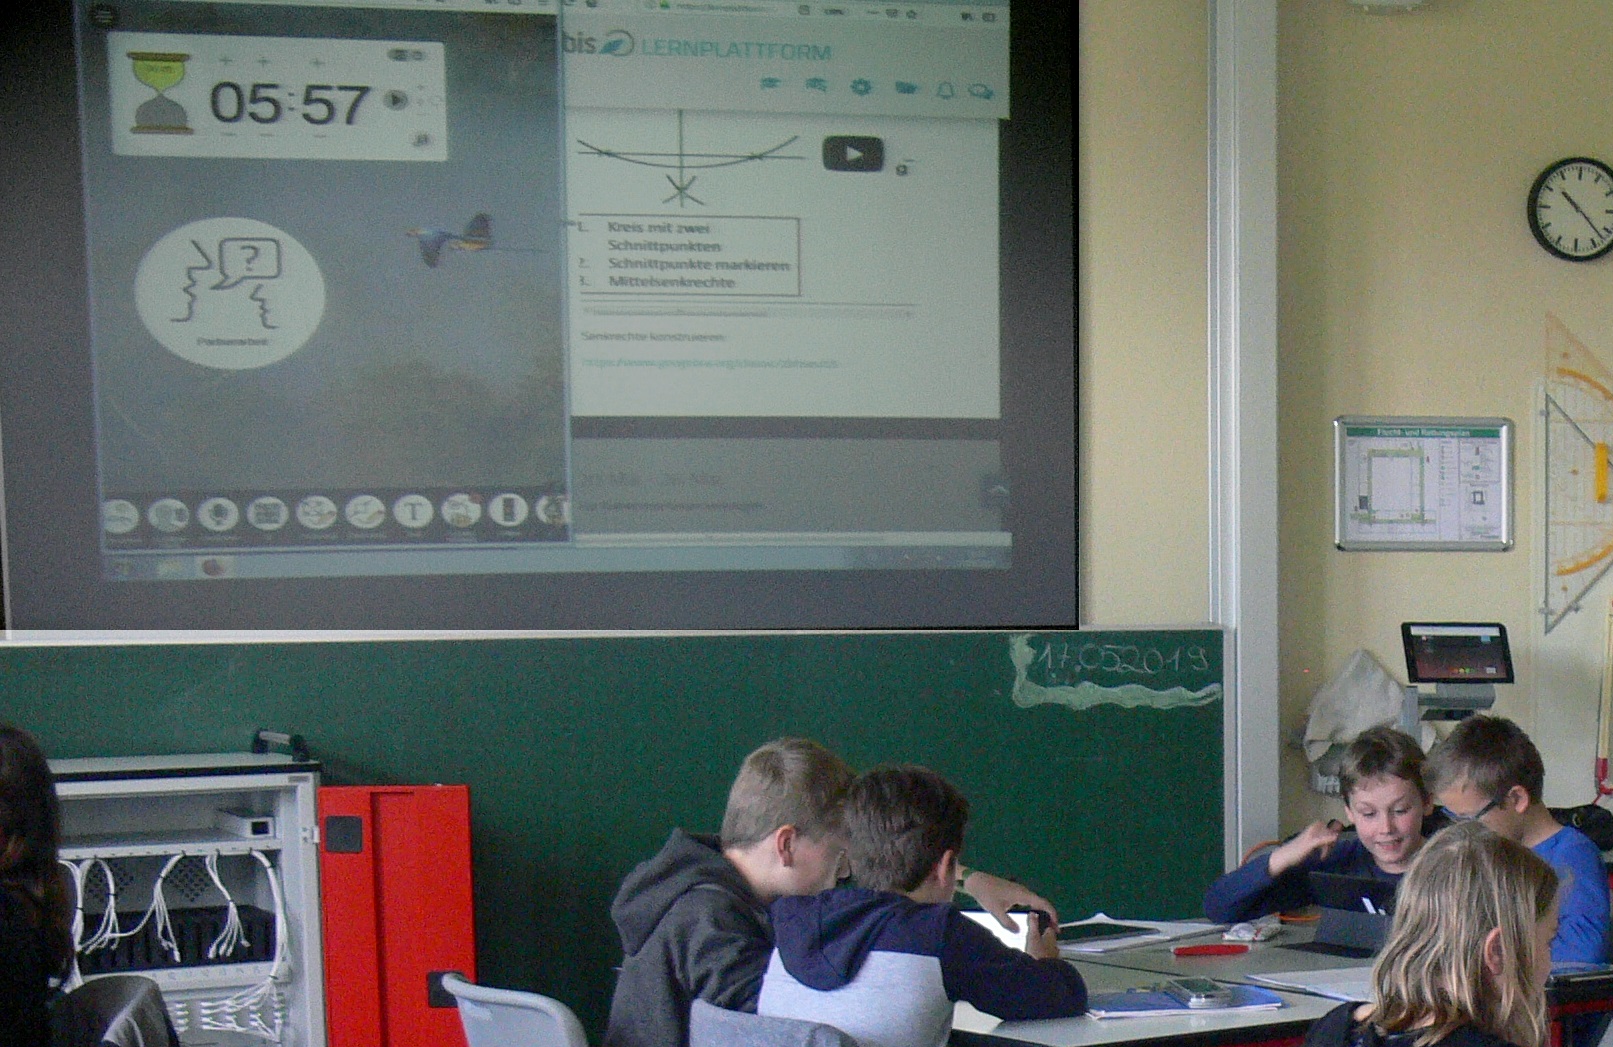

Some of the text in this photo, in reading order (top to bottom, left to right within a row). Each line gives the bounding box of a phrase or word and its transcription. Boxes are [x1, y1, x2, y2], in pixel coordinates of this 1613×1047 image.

[642, 38, 832, 61] LERNPLATTFORM
[210, 80, 372, 126] 05:57
[607, 221, 644, 234] Kreis
[647, 222, 673, 234] mit
[676, 223, 711, 235] zwei
[607, 239, 722, 254] Schnittpunkten
[608, 257, 712, 272] Schnittpunkte
[714, 260, 791, 272] markieren
[608, 275, 736, 289] Mittelsenkrechte
